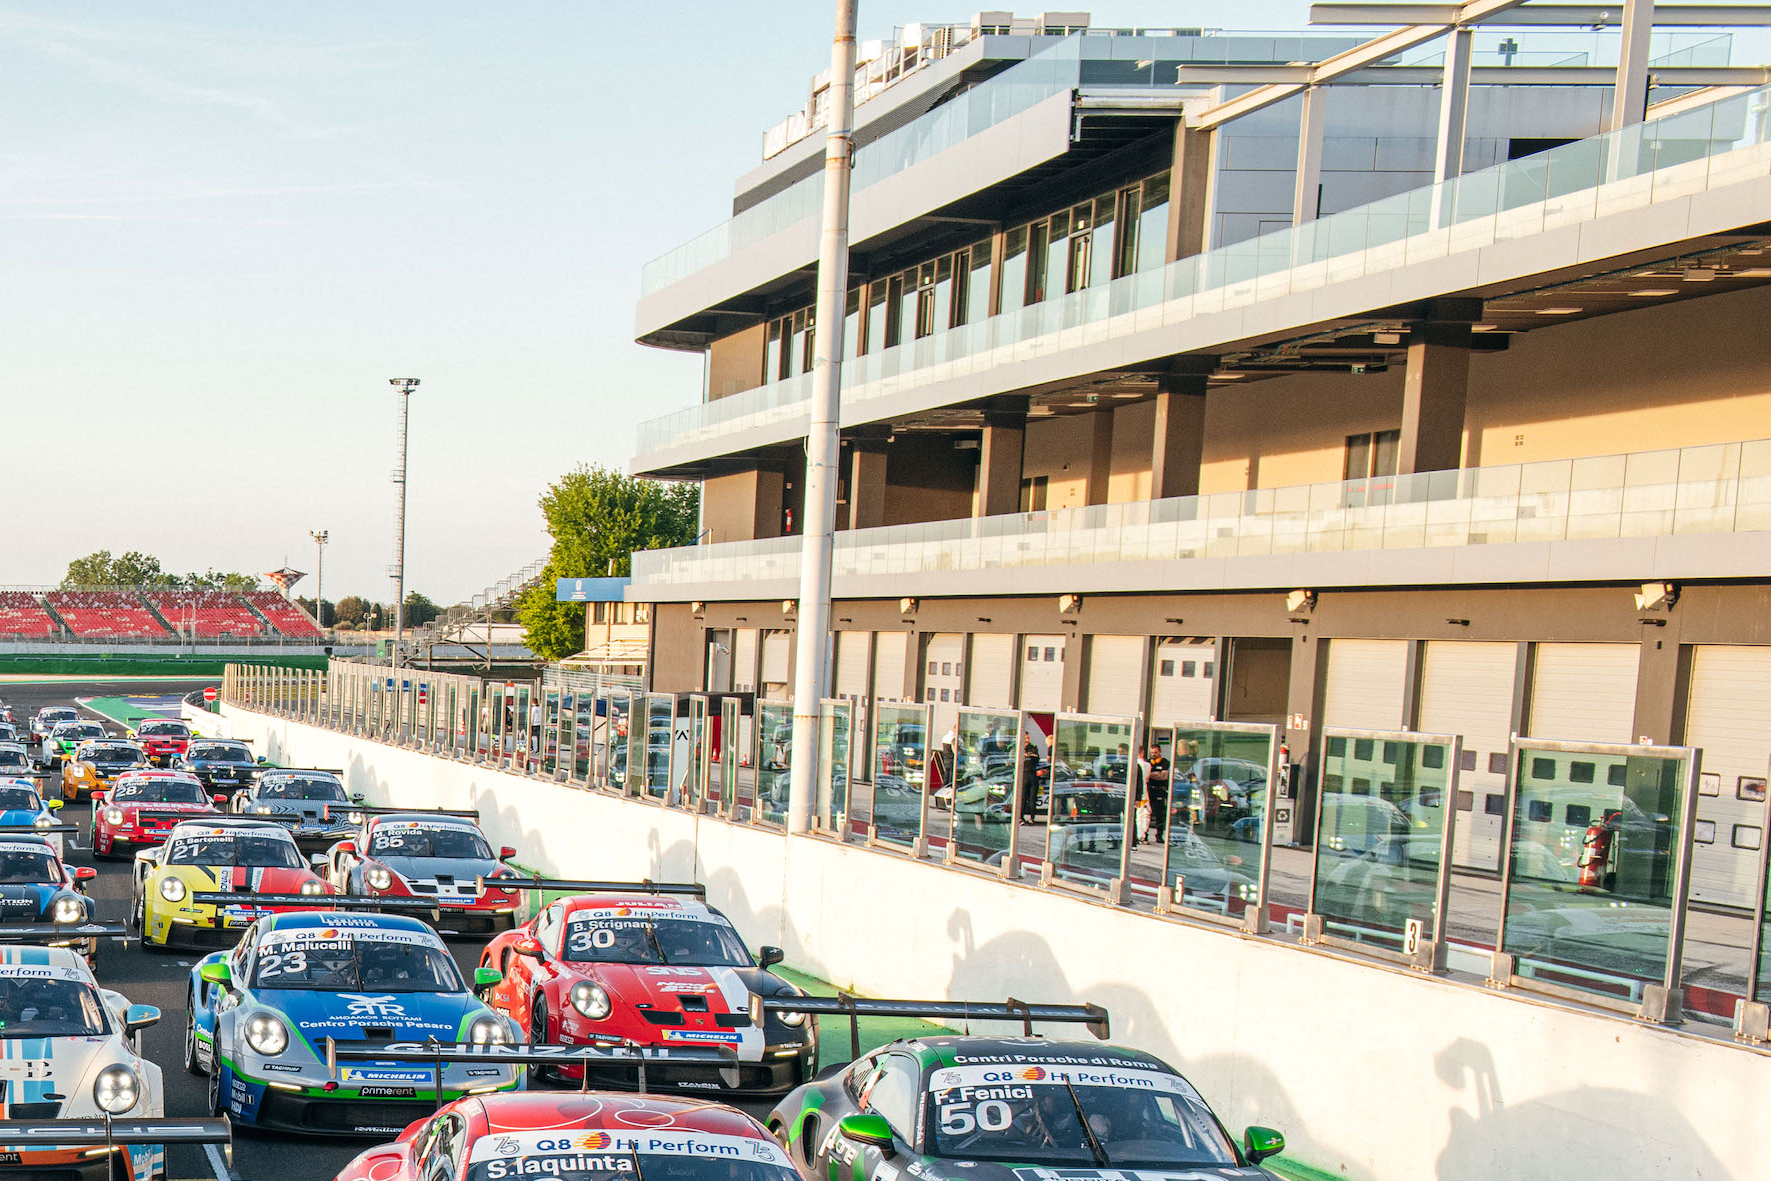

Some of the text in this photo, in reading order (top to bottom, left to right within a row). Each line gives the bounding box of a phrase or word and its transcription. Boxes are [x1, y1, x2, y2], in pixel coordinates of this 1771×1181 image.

[116, 786, 138, 797] 28
[264, 784, 286, 793] 70
[375, 835, 404, 850] 85
[173, 844, 200, 860] 21
[650, 911, 698, 920] Perform
[574, 920, 658, 932] B. Strignano
[295, 932, 412, 942] Q8 Perform
[570, 928, 616, 952] 30
[1408, 922, 1417, 954] 3
[259, 940, 352, 957] M. Malucelli
[259, 952, 308, 979] 23
[300, 1020, 453, 1030] Centro Porsche Pesaro
[953, 1054, 1159, 1070] Centri Porsche di Roma
[983, 1071, 1014, 1082] Q8
[1078, 1072, 1154, 1088] Perform
[362, 1087, 414, 1096] primerent
[935, 1085, 1034, 1105] F. Fenici
[940, 1100, 1014, 1136] 50
[494, 1136, 776, 1162] 75 Q8 Hi Perform 75
